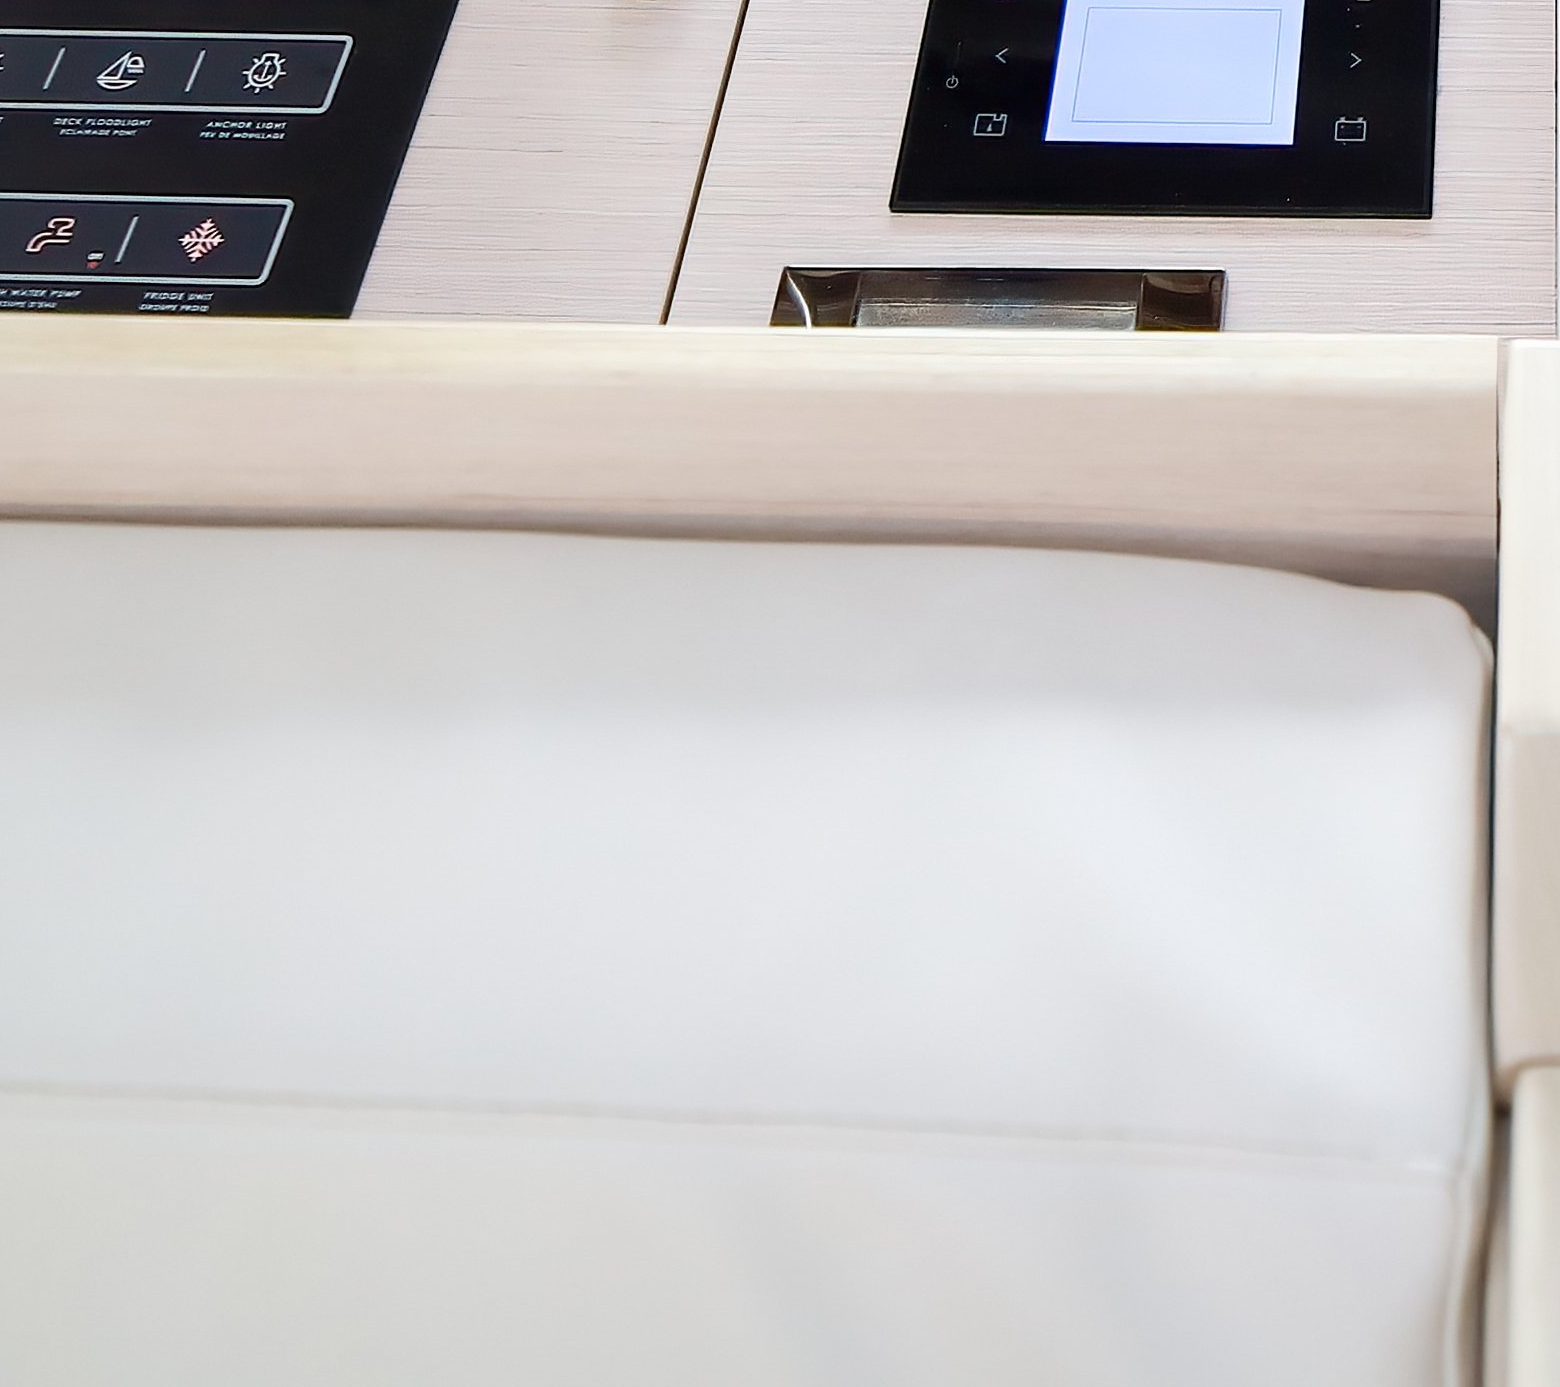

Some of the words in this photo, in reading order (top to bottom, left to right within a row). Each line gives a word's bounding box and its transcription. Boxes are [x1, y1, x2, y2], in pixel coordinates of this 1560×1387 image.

[53, 117, 83, 126] DECK
[85, 118, 153, 127] FLOODLIGHT
[206, 120, 253, 129] ANCHOR
[255, 121, 287, 130] LIGHT
